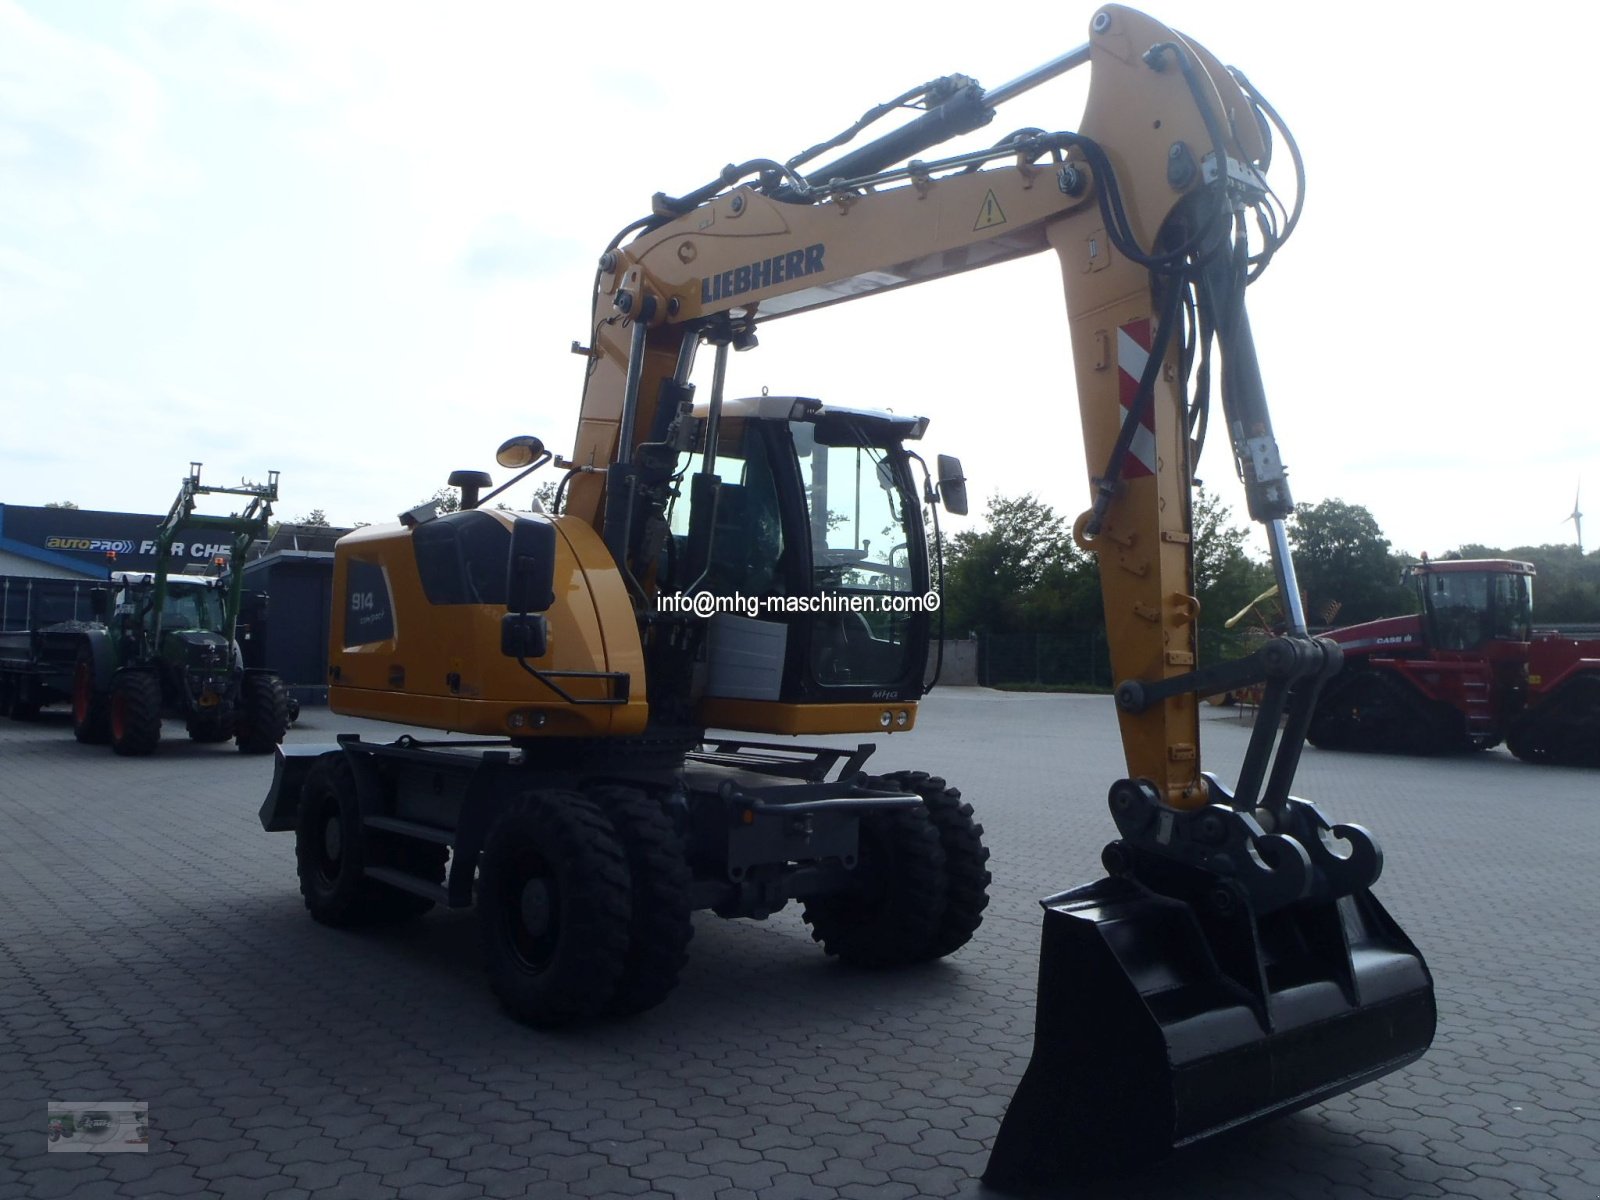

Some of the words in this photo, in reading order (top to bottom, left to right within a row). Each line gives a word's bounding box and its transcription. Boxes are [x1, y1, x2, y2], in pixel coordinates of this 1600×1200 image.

[701, 243, 825, 304] LIEBHERR
[190, 543, 232, 557] CHE
[352, 592, 373, 610] 914
[1376, 636, 1402, 644] CASE
